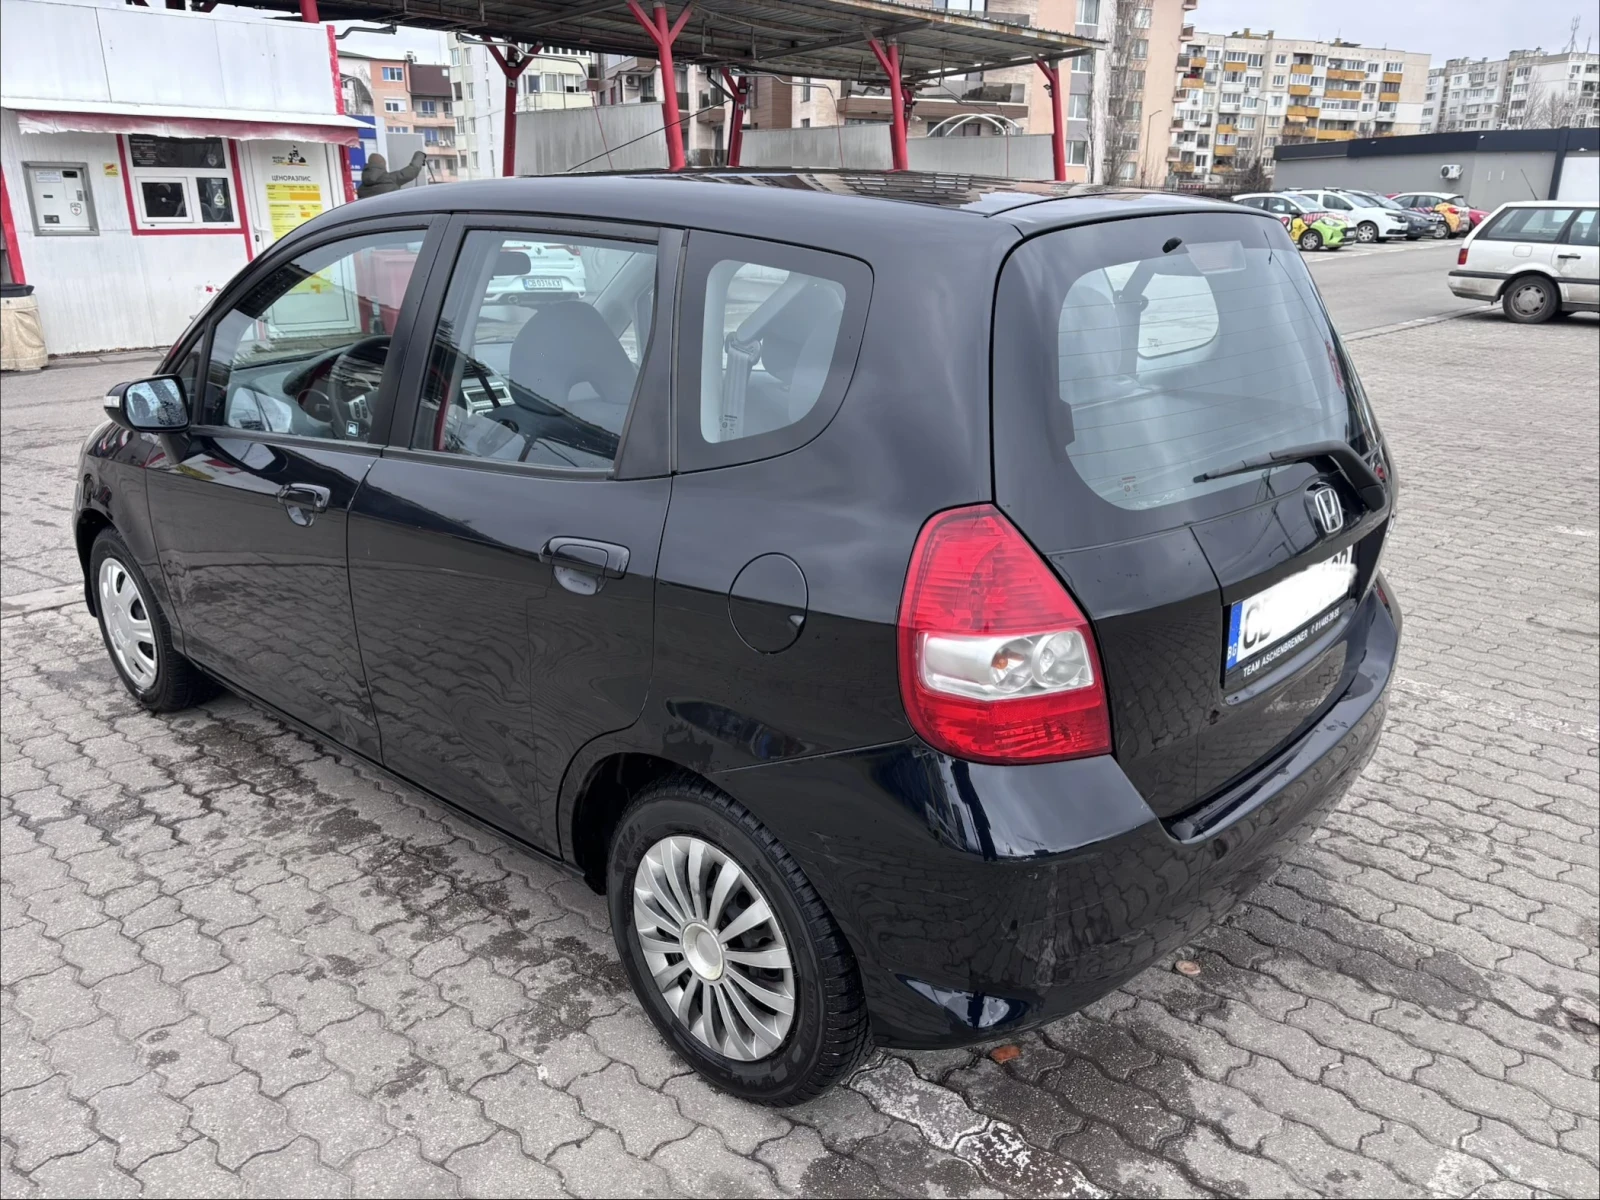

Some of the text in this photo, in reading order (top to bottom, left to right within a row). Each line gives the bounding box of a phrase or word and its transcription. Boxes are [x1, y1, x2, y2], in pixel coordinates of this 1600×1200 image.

[1227, 643, 1237, 661] BG
[1243, 660, 1260, 677] TEAM
[1261, 629, 1308, 667] ASCHENBRENNER
